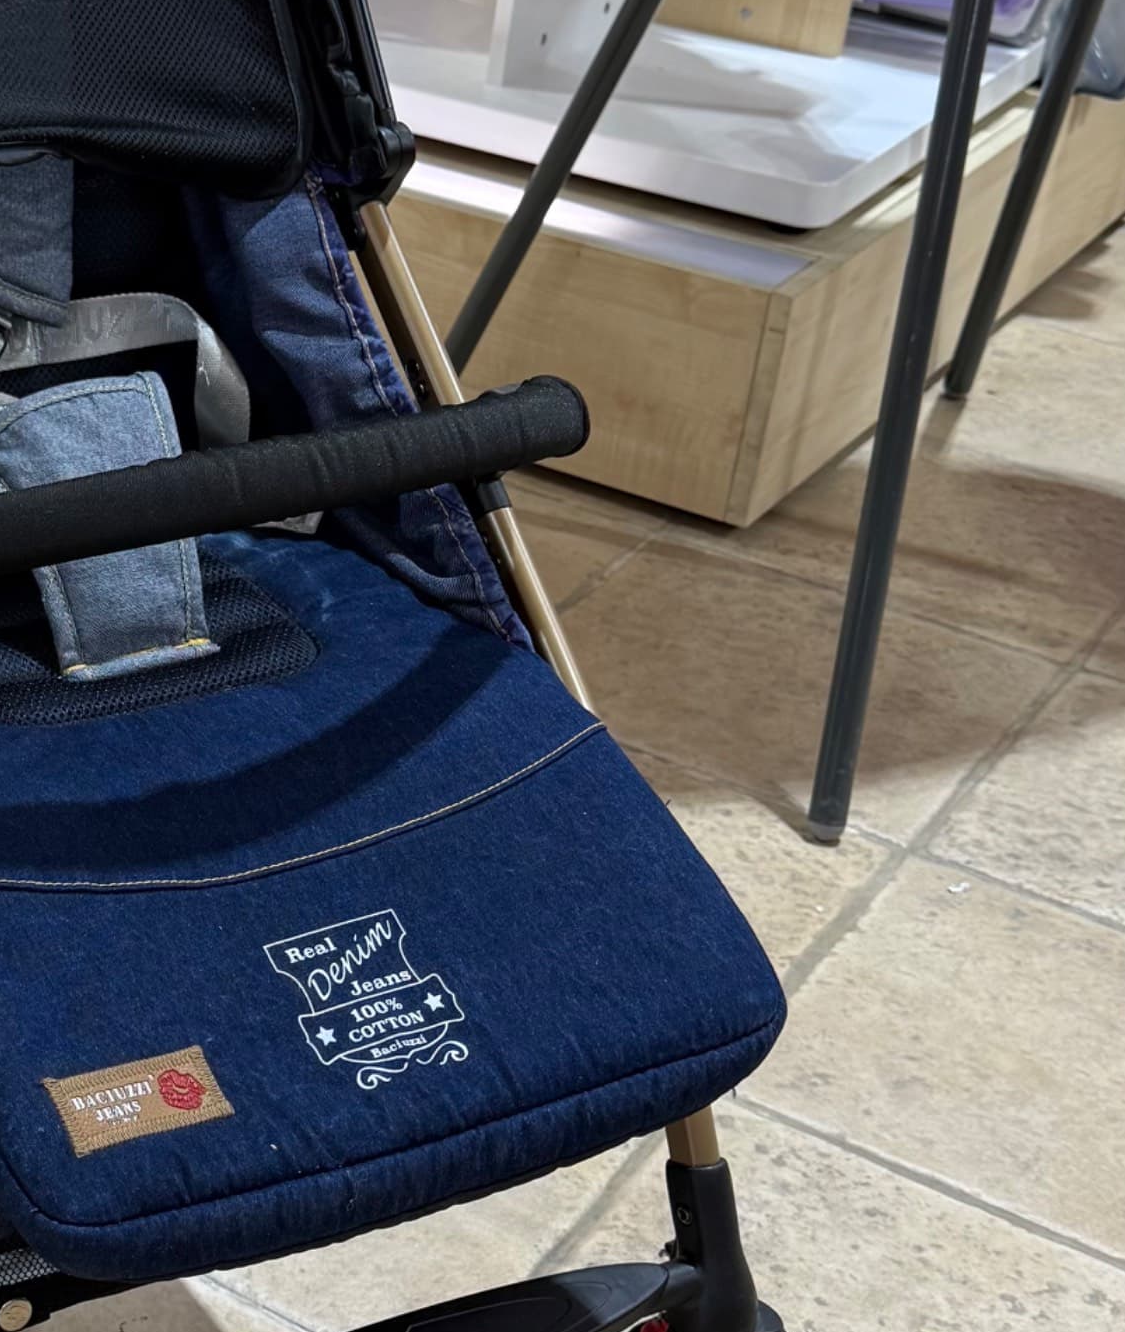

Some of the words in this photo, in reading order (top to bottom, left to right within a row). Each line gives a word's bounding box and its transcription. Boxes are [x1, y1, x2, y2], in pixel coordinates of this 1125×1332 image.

[284, 937, 338, 964] Real
[307, 919, 393, 1002] Denim
[350, 969, 413, 997] Jeans
[350, 996, 404, 1023] 100%
[348, 1009, 426, 1044] COTTON
[95, 1100, 142, 1122] JEANS
